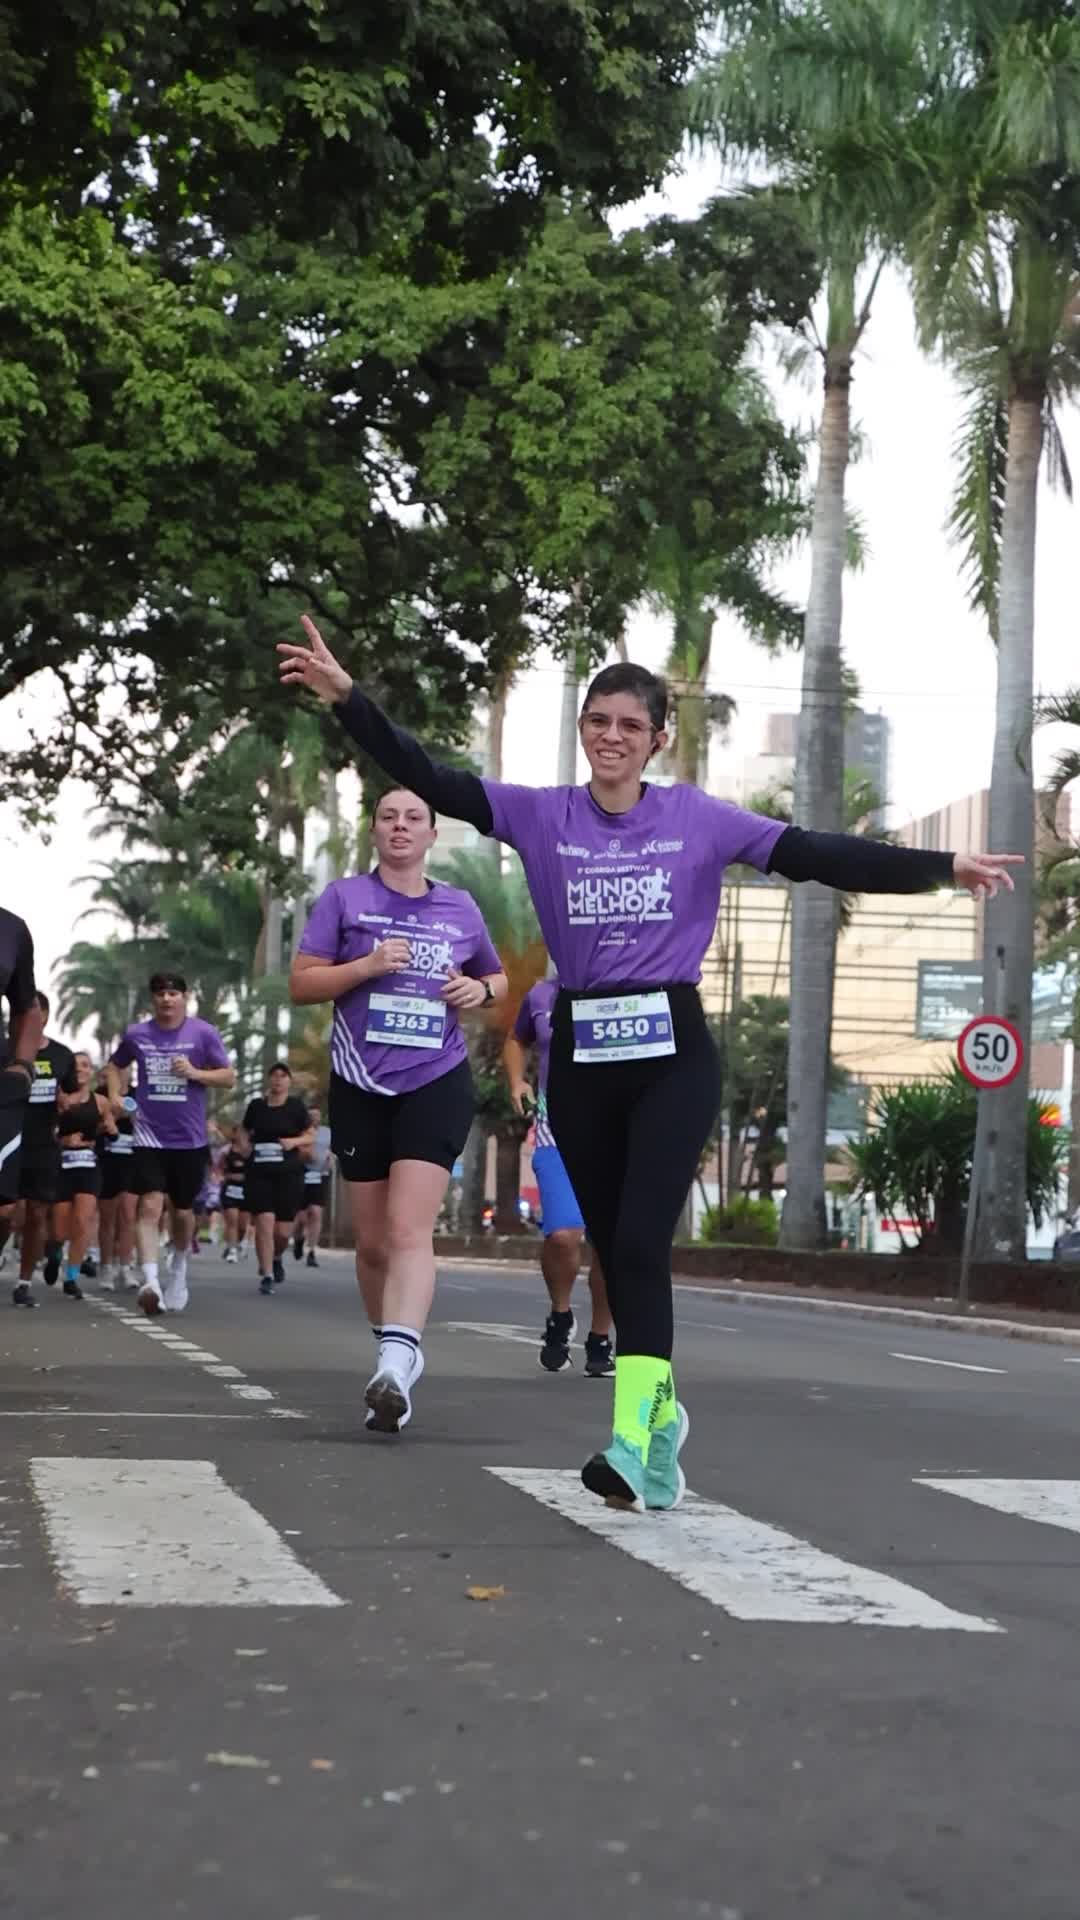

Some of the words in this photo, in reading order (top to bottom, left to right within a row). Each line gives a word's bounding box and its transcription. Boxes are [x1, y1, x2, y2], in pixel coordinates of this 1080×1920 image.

[567, 875, 654, 899] MUNDO
[567, 893, 656, 916] MELHOR
[383, 1012, 430, 1031] 5363
[592, 1017, 650, 1041] 5450
[972, 1032, 1010, 1063] 50
